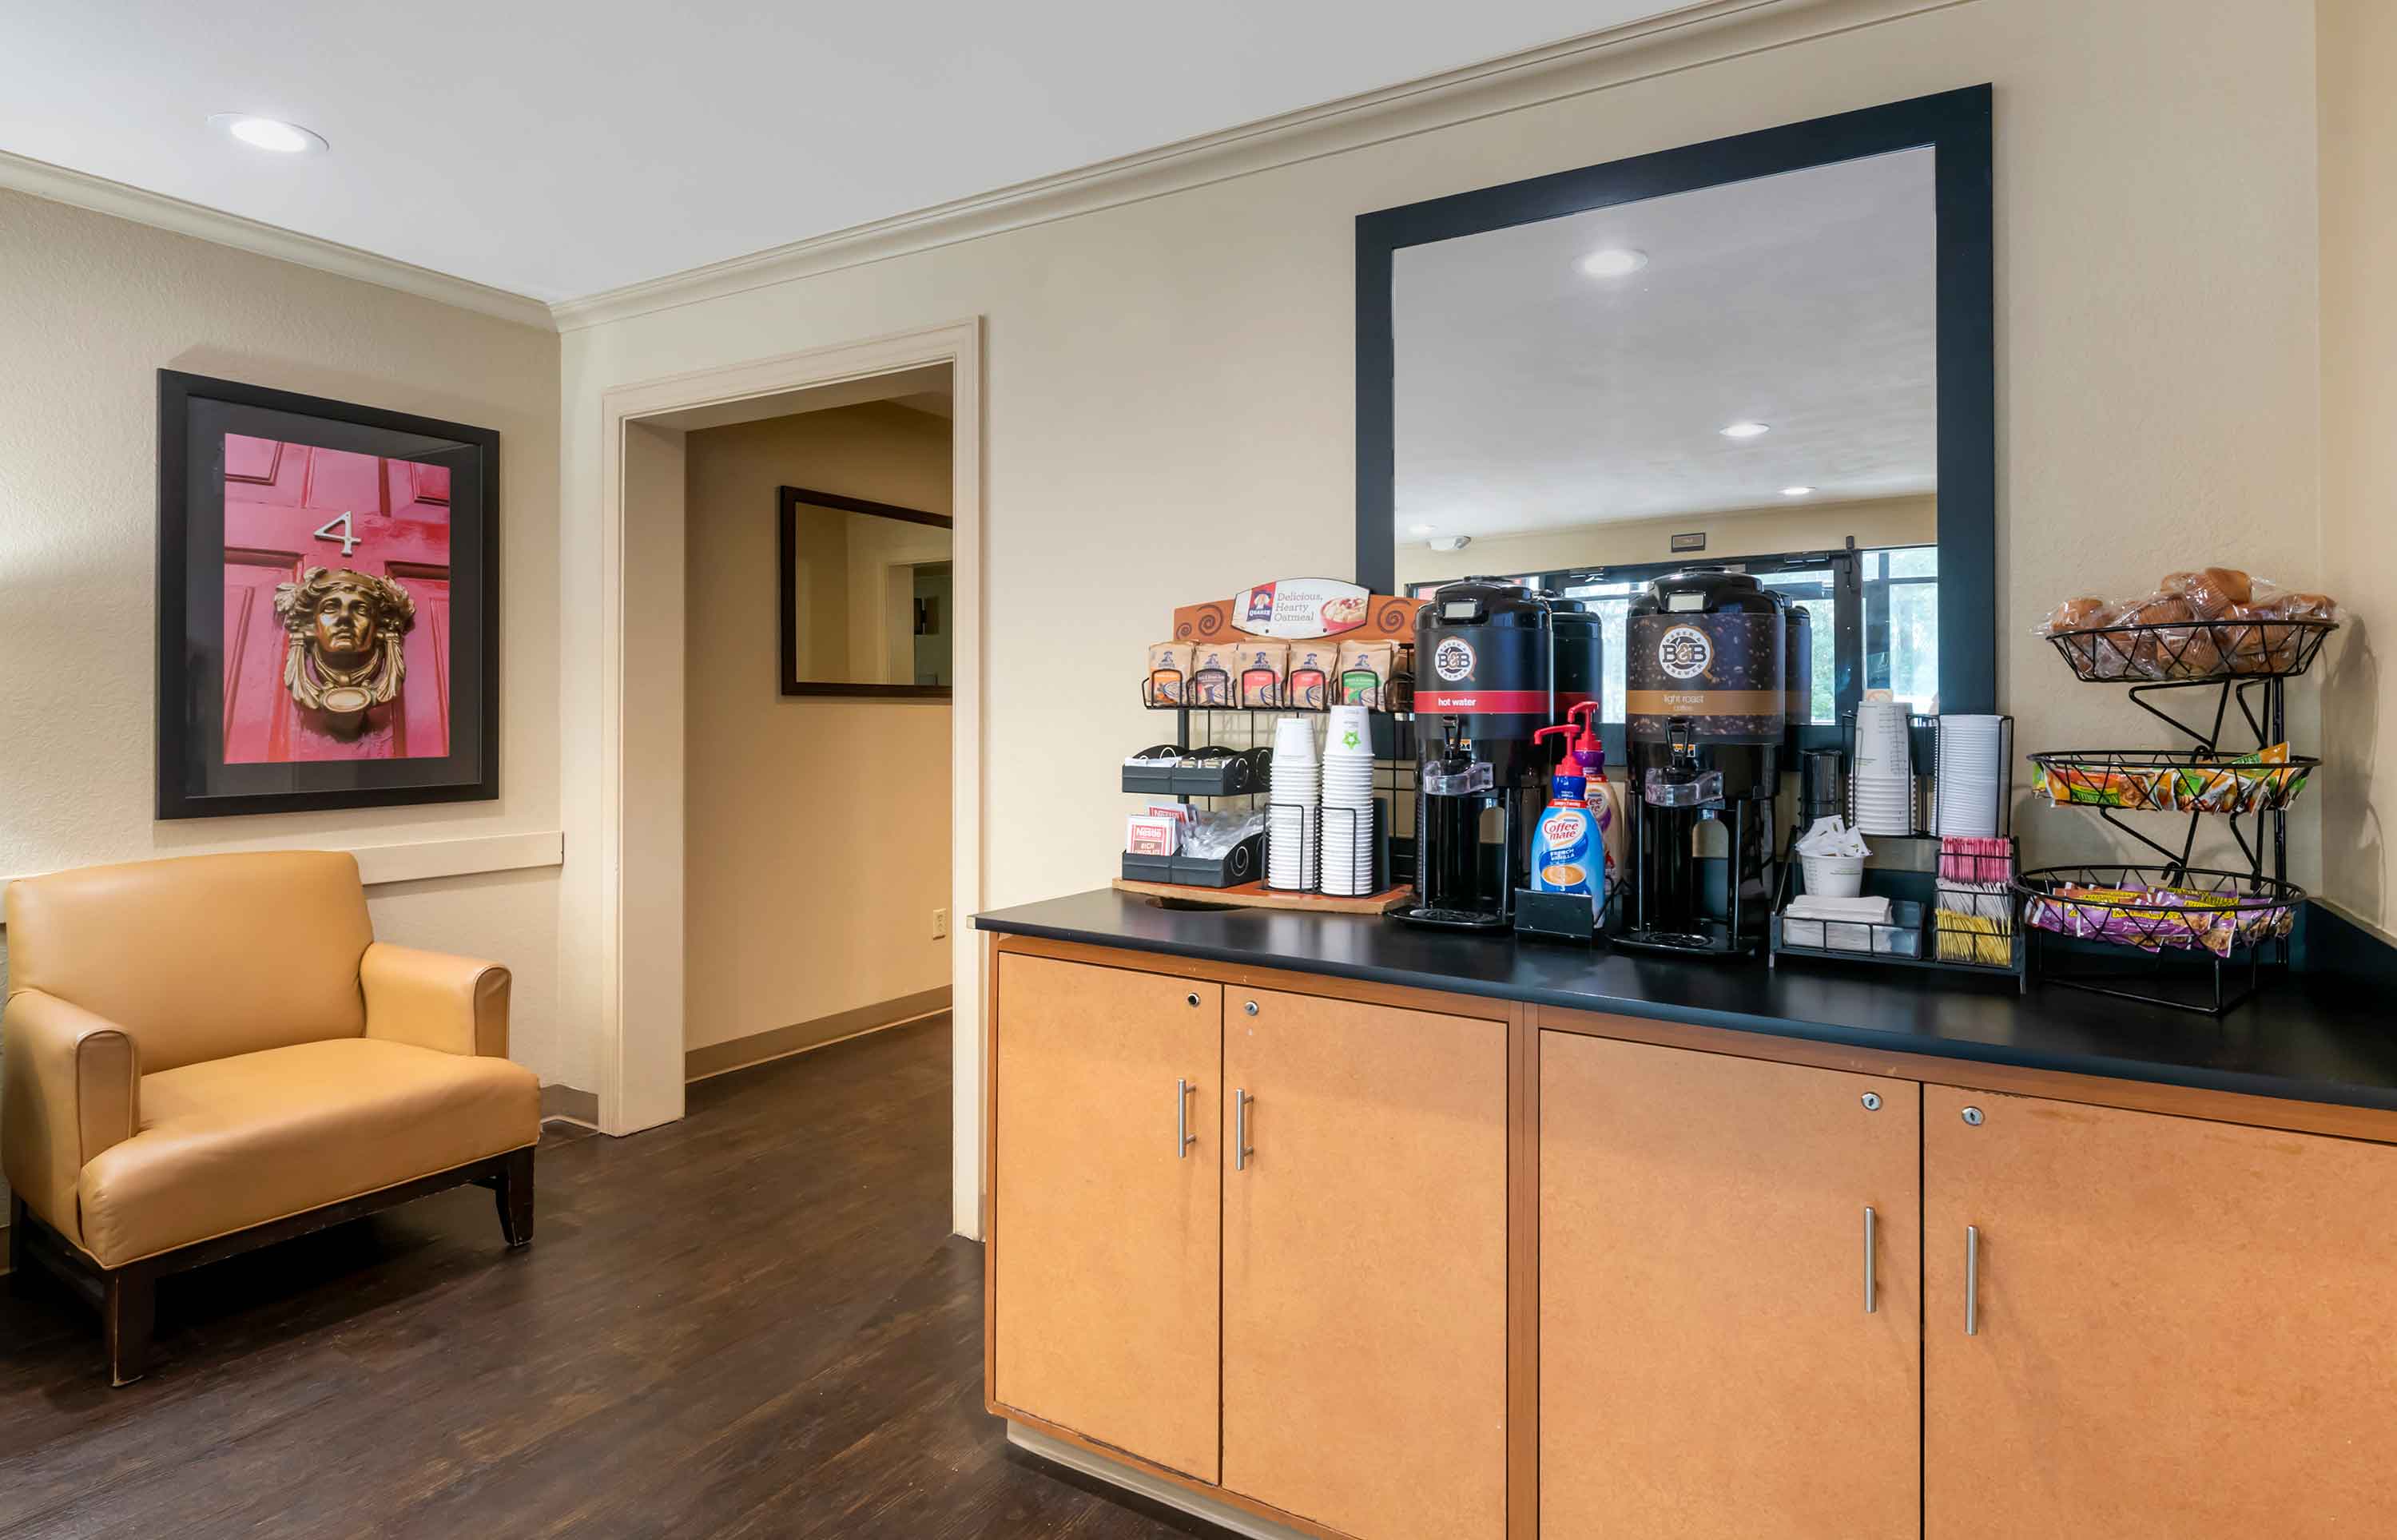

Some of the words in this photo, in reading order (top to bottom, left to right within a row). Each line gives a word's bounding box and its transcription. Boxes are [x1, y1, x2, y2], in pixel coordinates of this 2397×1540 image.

[313, 510, 361, 557] 4
[1277, 592, 1323, 601] Delicious,
[1276, 602, 1309, 613] Hearty
[1274, 613, 1314, 621] Oatmeal
[1438, 697, 1451, 706] hot
[1544, 820, 1579, 834] Coffee
[1550, 830, 1576, 840] mate
